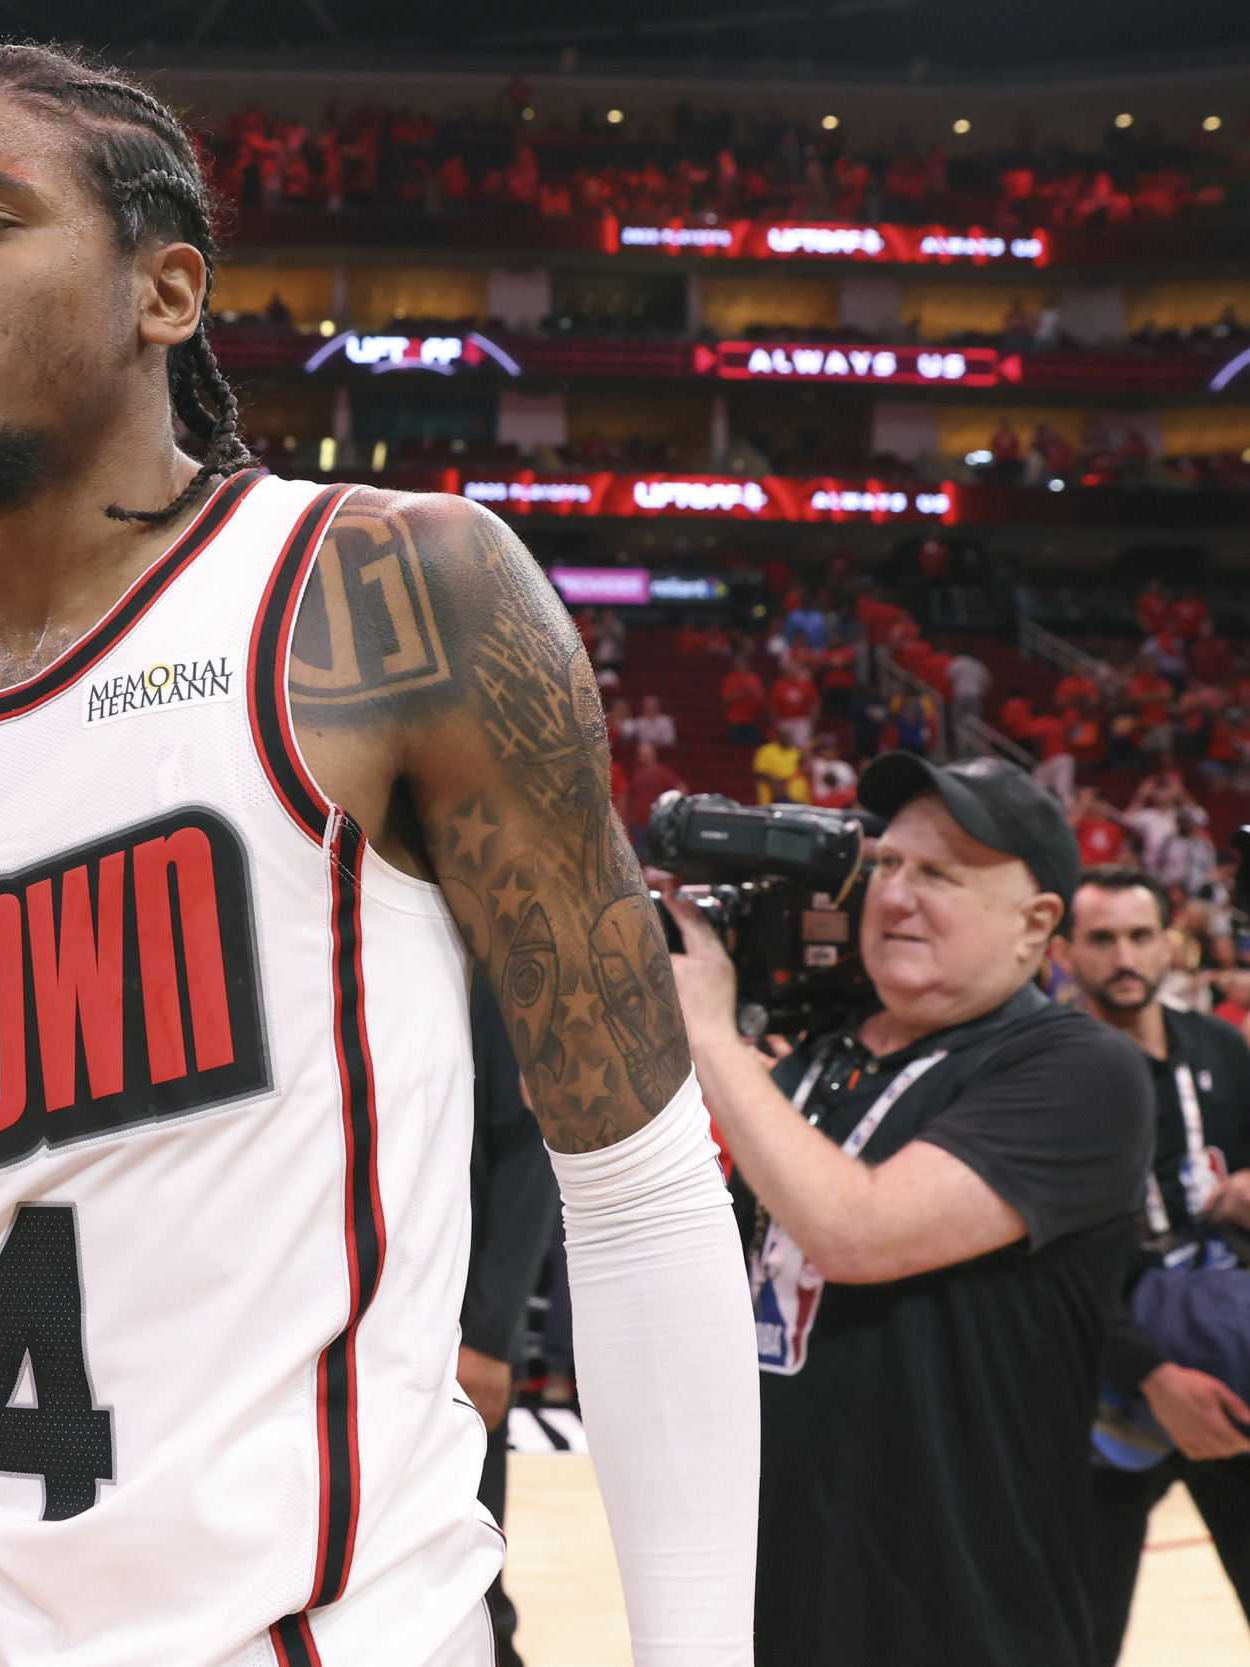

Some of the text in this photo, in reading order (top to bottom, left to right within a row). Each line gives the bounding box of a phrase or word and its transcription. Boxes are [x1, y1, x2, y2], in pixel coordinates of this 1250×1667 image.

[747, 347, 967, 380] ALWAYS US
[86, 673, 230, 722] HERMANN
[89, 656, 233, 705] MEMORIAL
